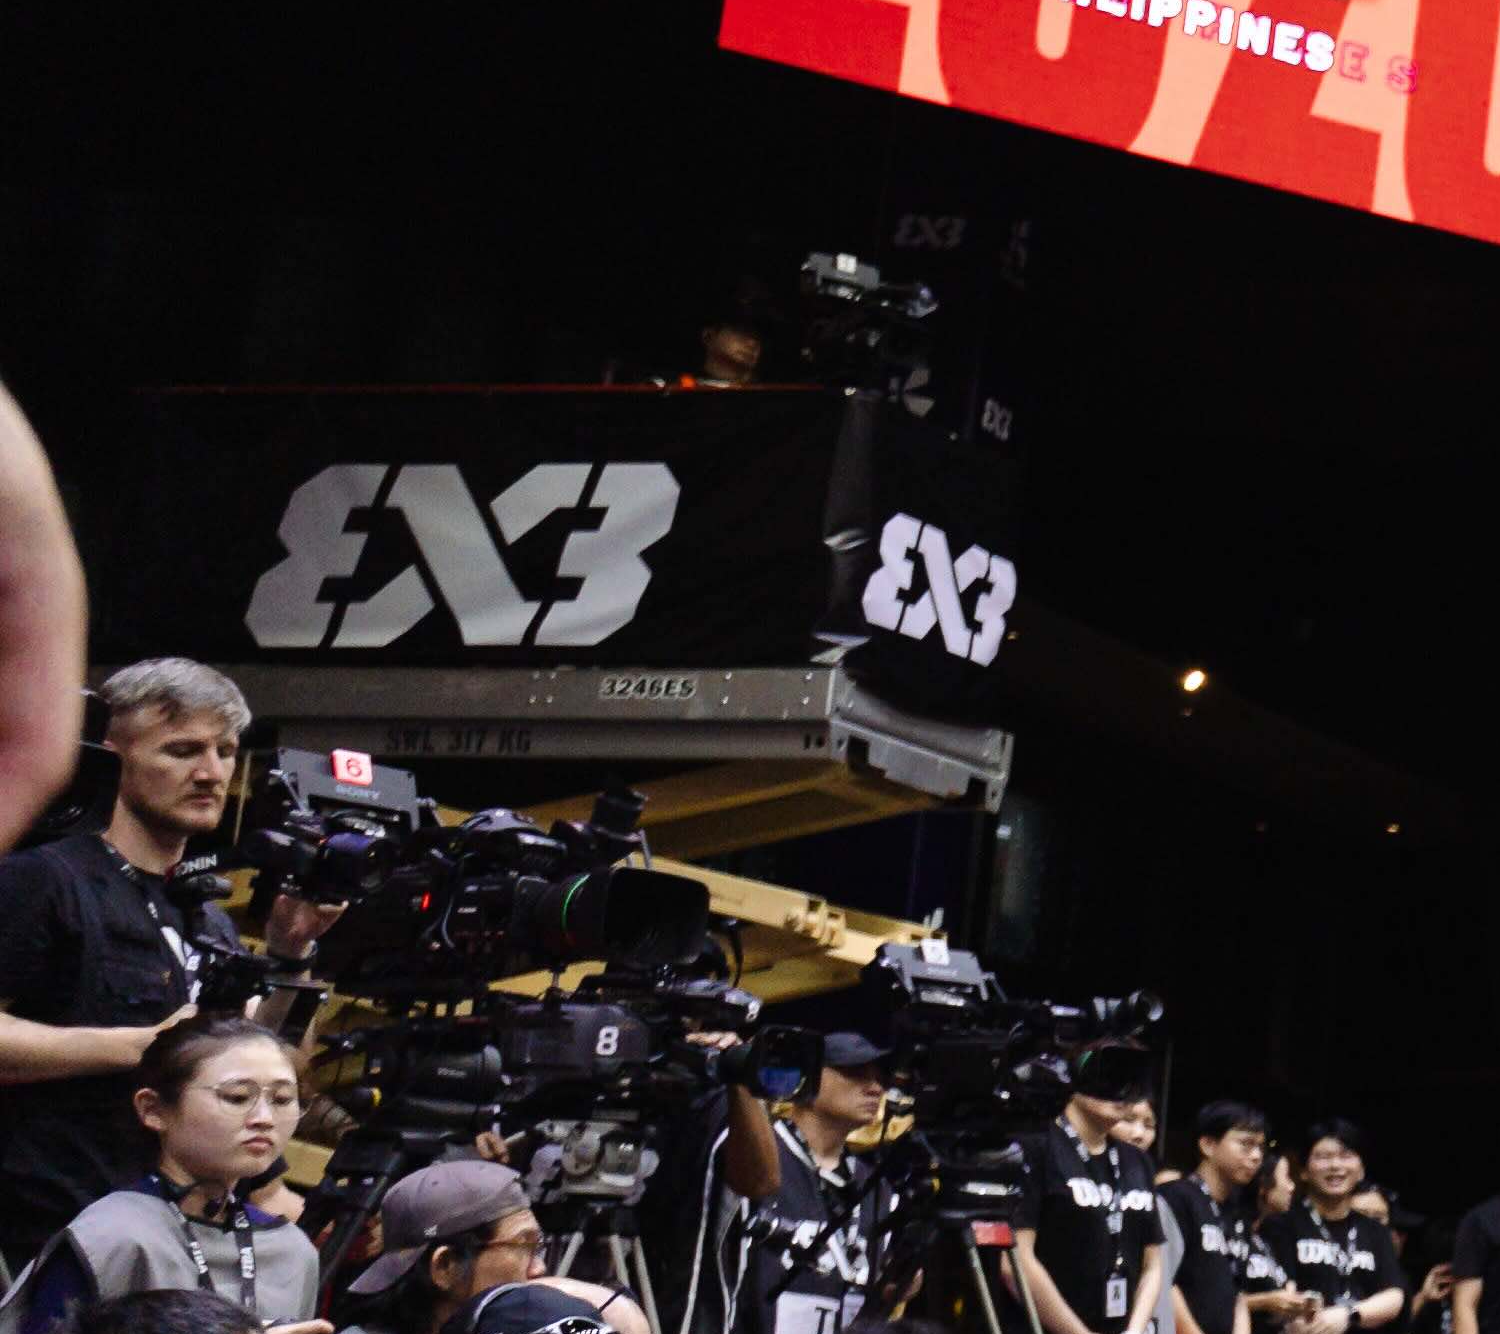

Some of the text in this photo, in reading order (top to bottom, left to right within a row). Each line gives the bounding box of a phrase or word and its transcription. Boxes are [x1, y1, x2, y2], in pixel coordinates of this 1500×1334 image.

[499, 728, 532, 754] KG
[345, 758, 363, 778] 6
[595, 1025, 618, 1057] 8
